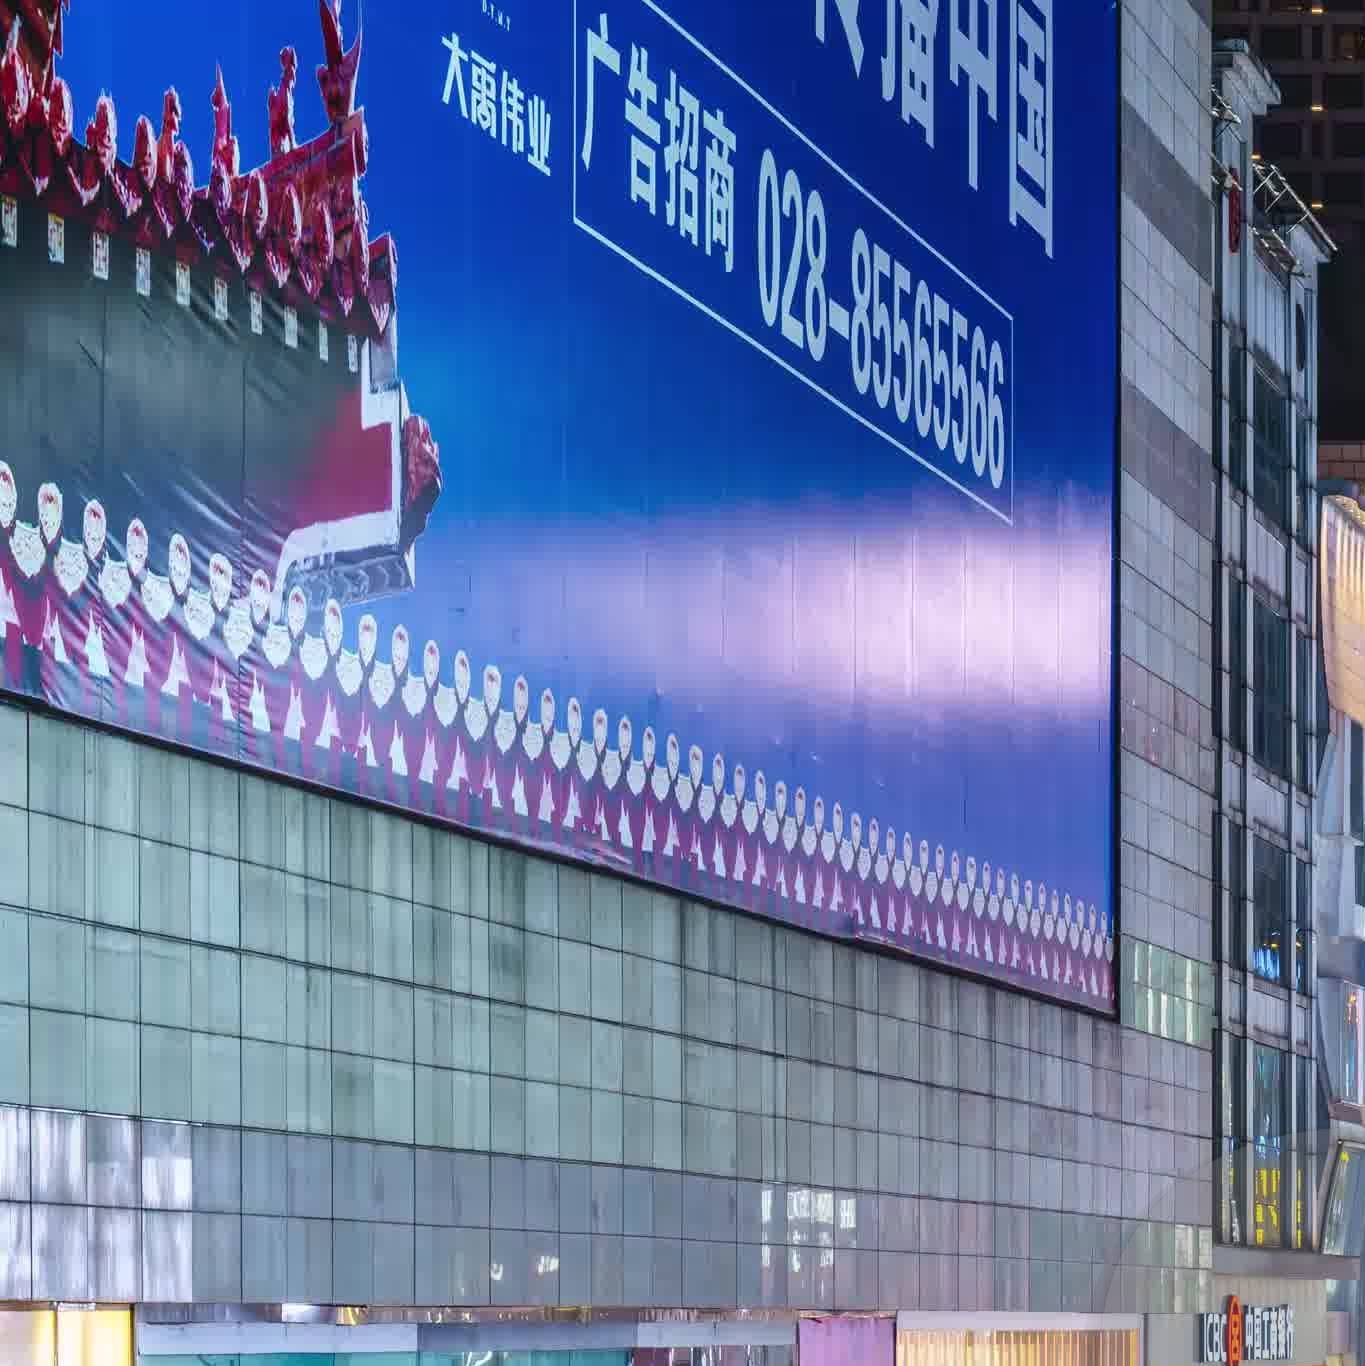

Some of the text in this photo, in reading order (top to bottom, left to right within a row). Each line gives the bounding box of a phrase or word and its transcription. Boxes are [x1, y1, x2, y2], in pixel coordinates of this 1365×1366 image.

[441, 32, 551, 177] 大禹伟业
[815, 0, 1053, 259] 播中国
[581, 13, 1005, 490] 广告招商 028-85565566
[1204, 1304, 1294, 1362] ICBC 中国工商银行
